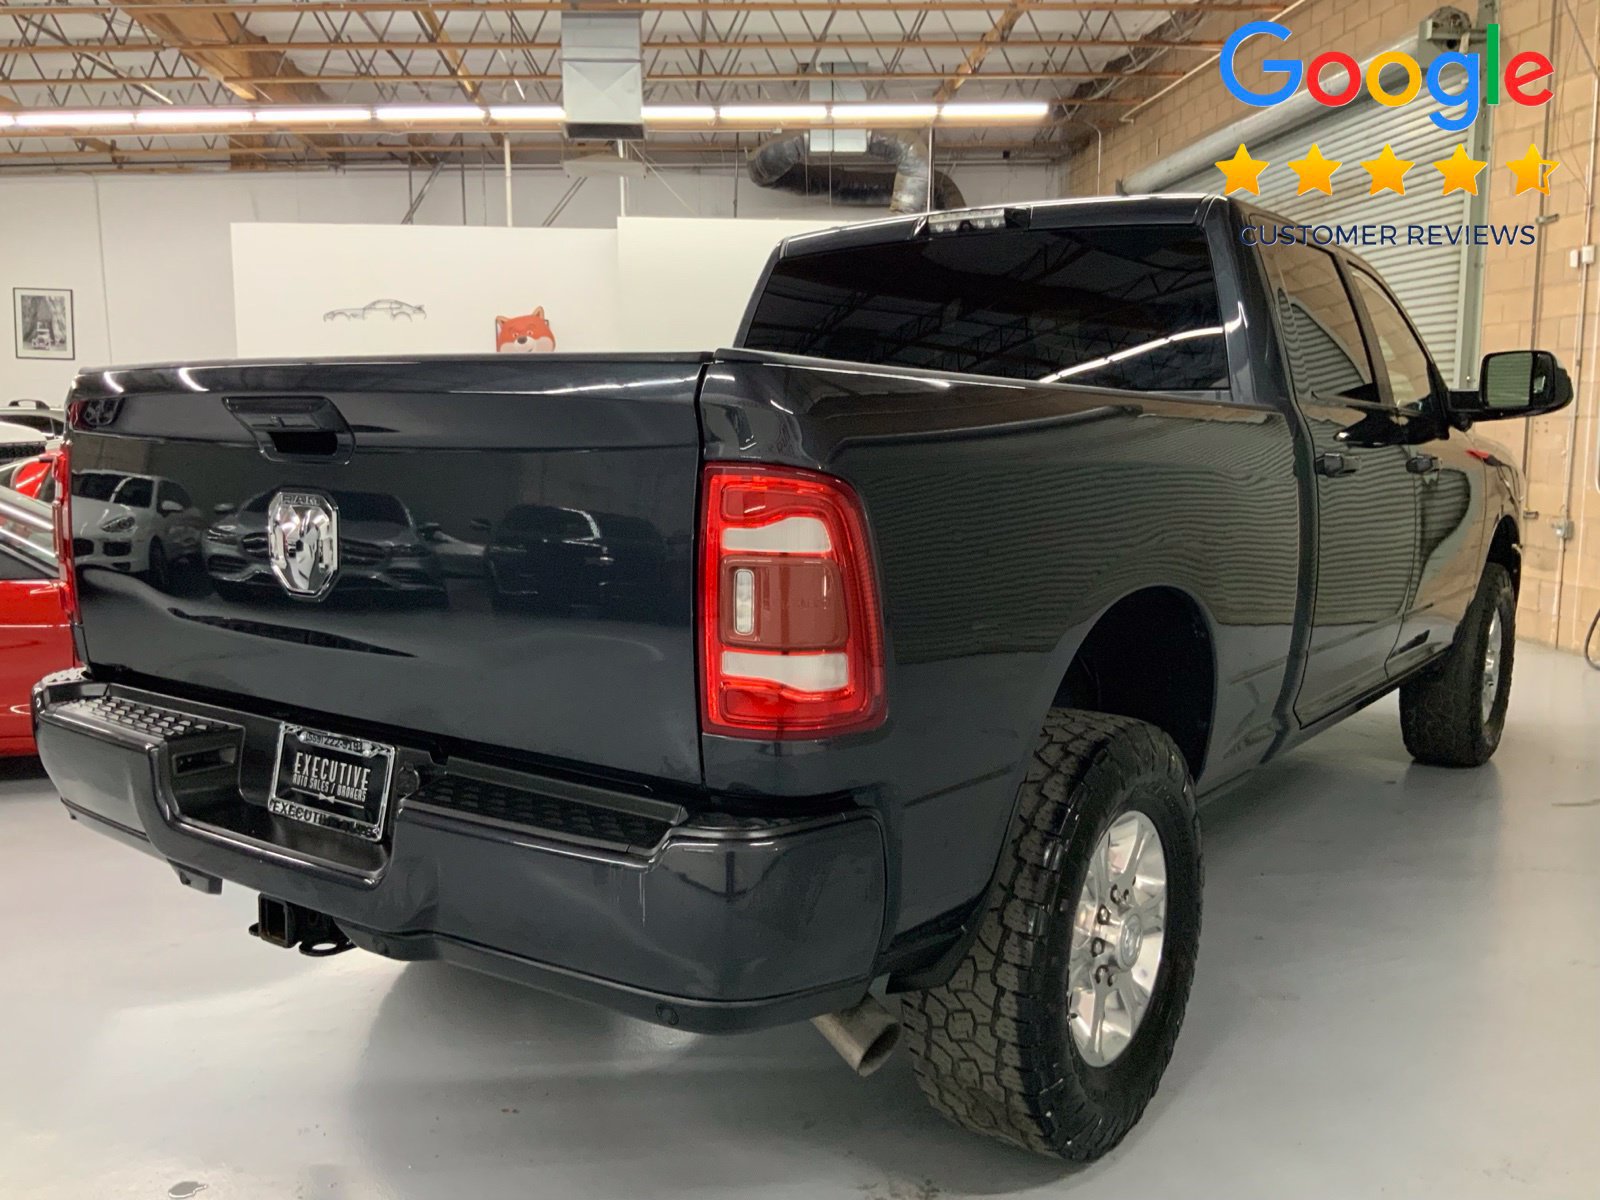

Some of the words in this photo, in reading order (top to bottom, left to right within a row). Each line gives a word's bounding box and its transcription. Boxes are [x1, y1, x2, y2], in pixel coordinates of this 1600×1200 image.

[292, 773, 308, 787] AUTO
[309, 778, 329, 792] SALES
[337, 788, 366, 802] BROKERS
[294, 752, 371, 791] EXECUTIVE
